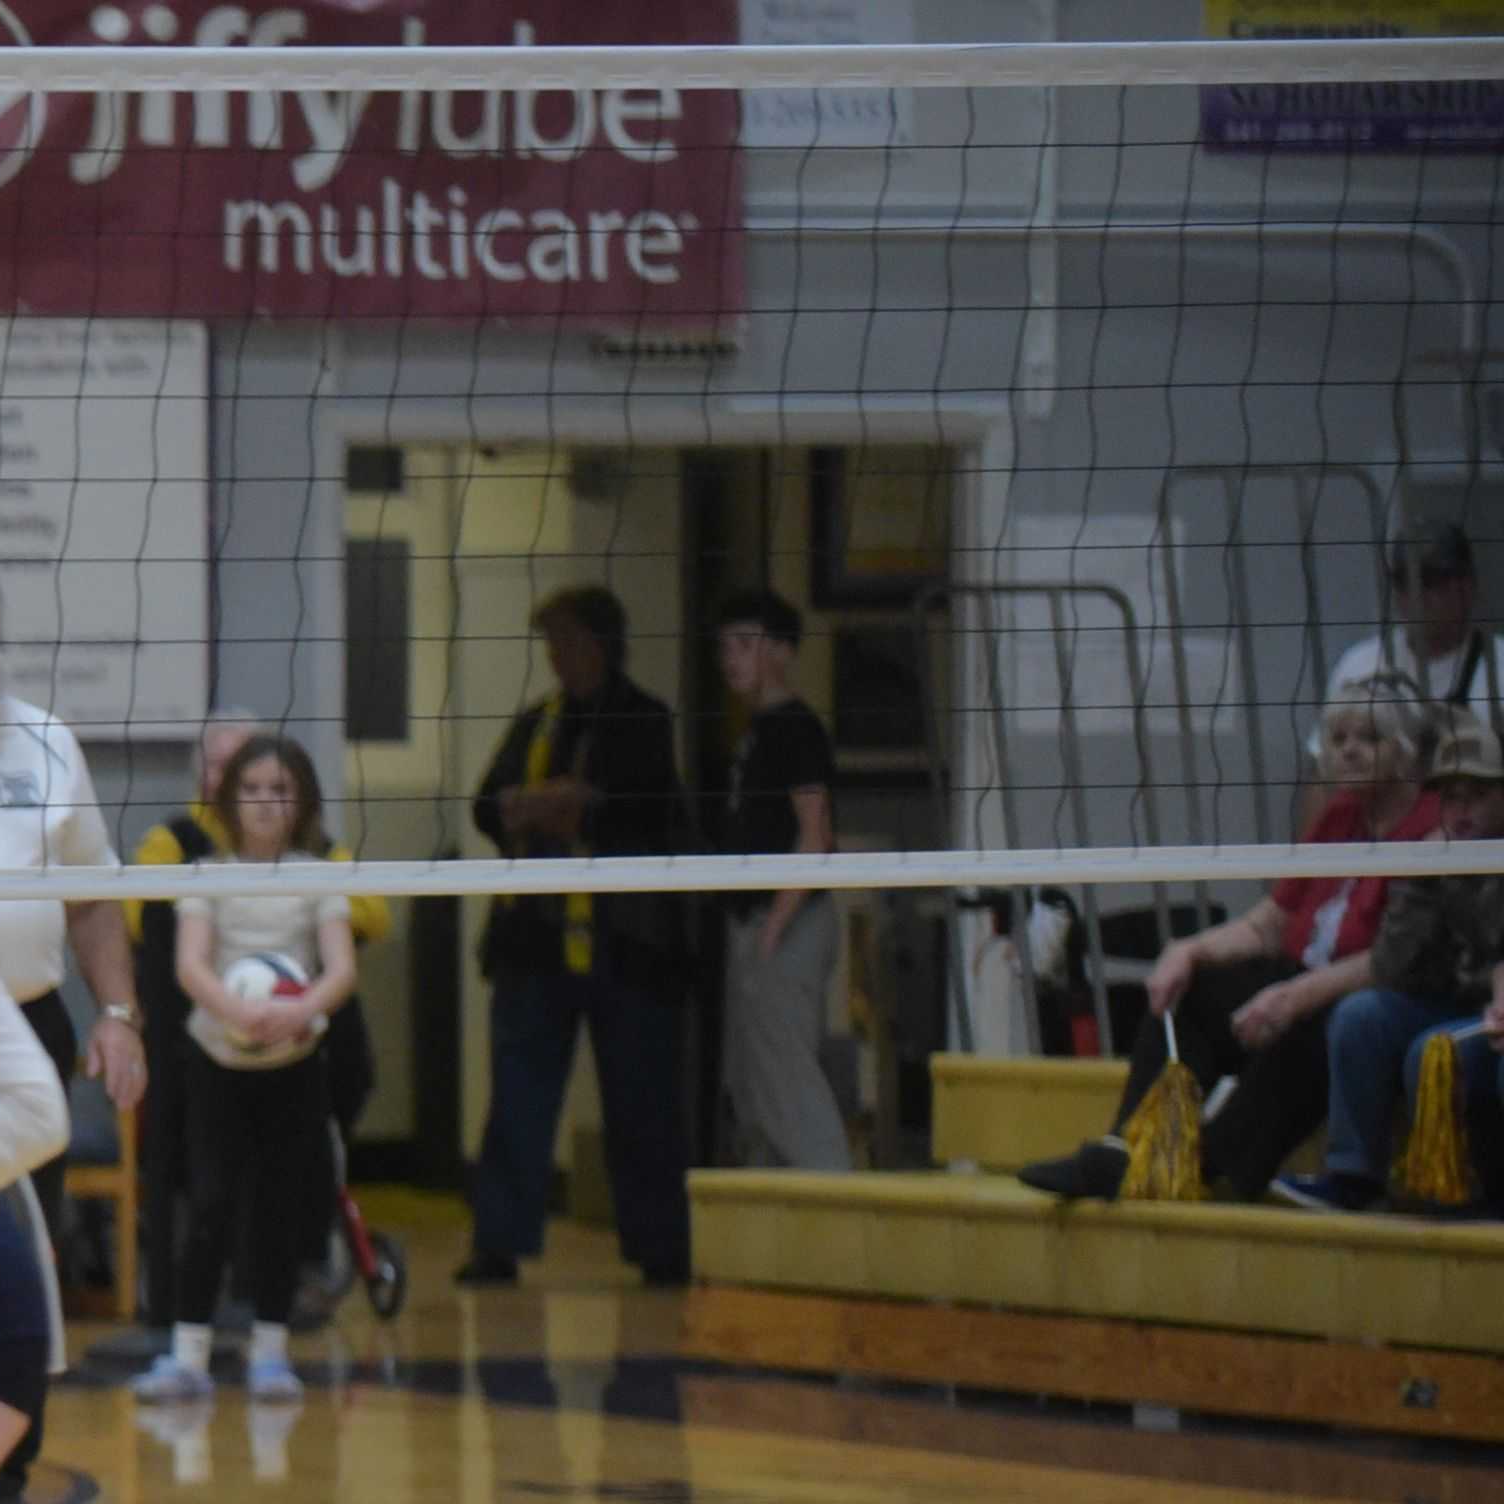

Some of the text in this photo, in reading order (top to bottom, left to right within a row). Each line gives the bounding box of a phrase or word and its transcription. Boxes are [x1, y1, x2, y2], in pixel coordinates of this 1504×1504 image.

[70, 5, 684, 191] jiffy lube
[223, 176, 684, 284] multicare
